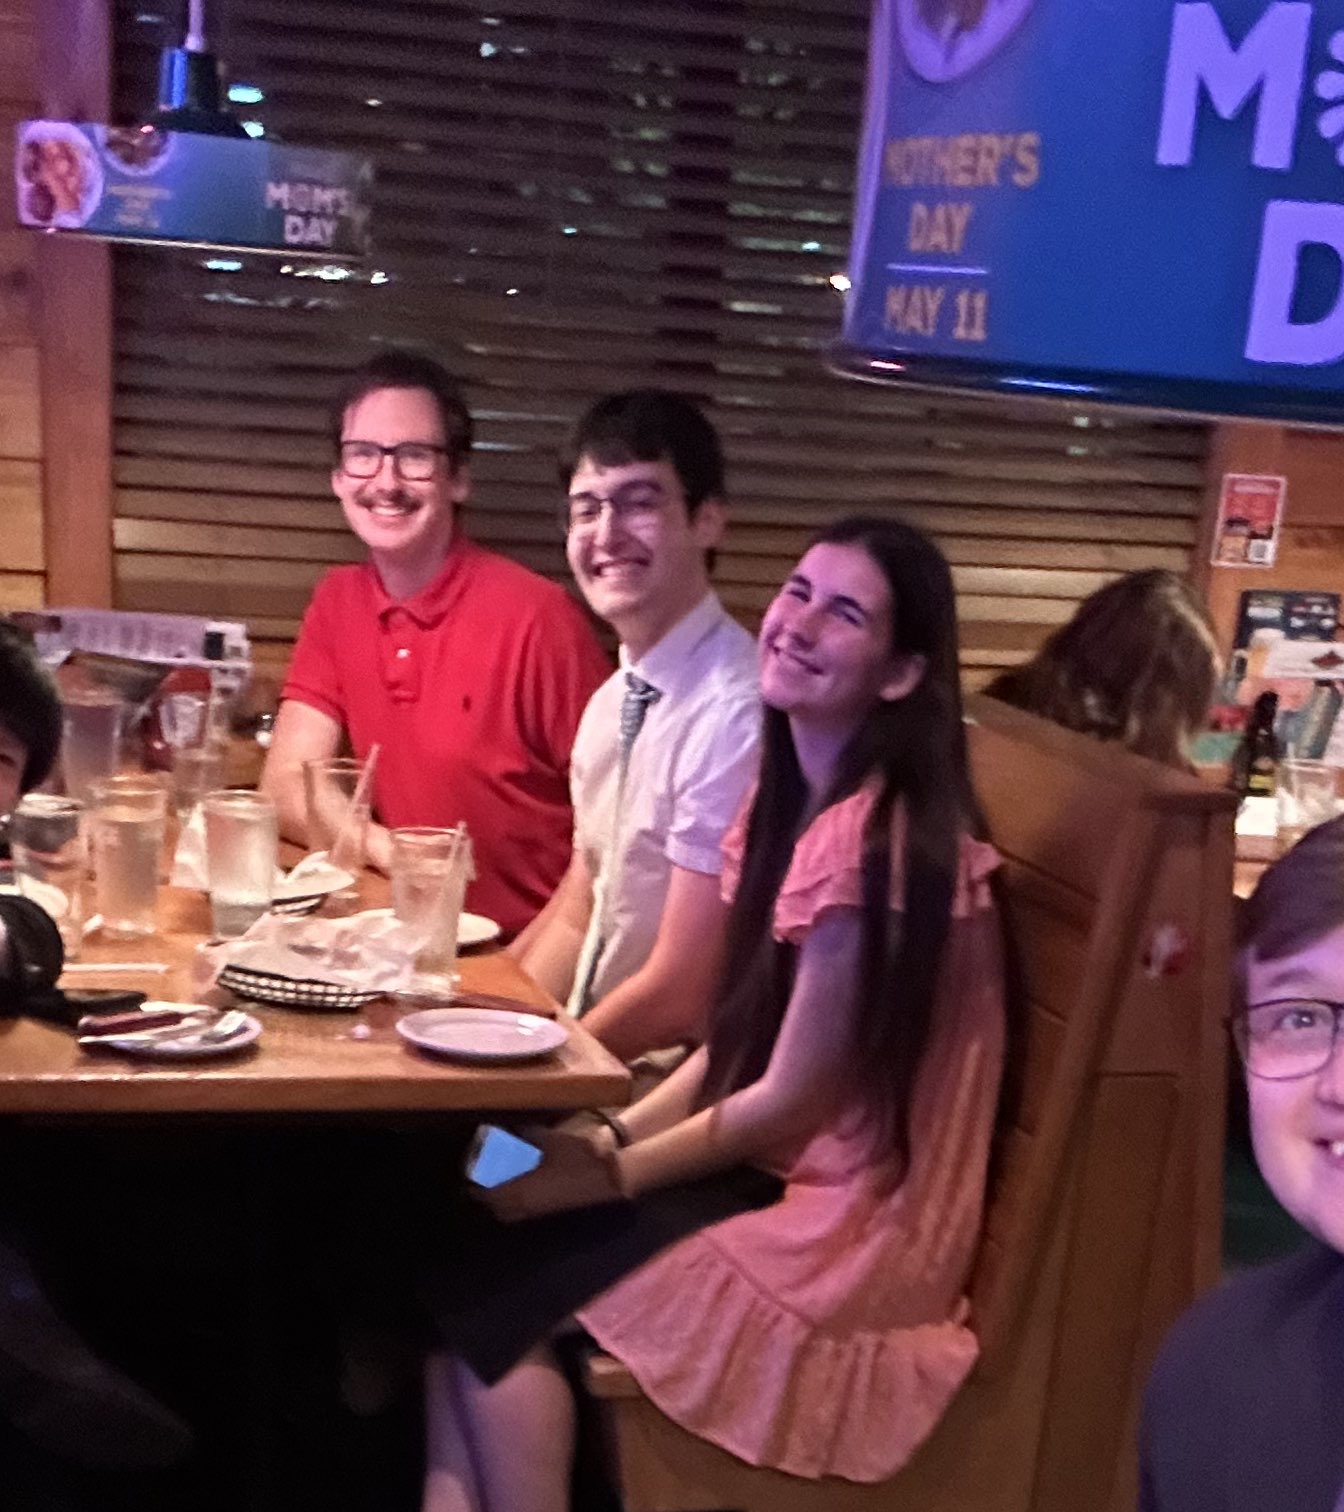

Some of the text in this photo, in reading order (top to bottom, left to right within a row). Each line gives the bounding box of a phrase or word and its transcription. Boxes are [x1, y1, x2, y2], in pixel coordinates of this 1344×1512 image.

[885, 131, 1041, 188] MOTHER'S
[284, 214, 337, 245] DAY
[909, 203, 973, 254] DAY
[884, 286, 987, 341] MAY 11
